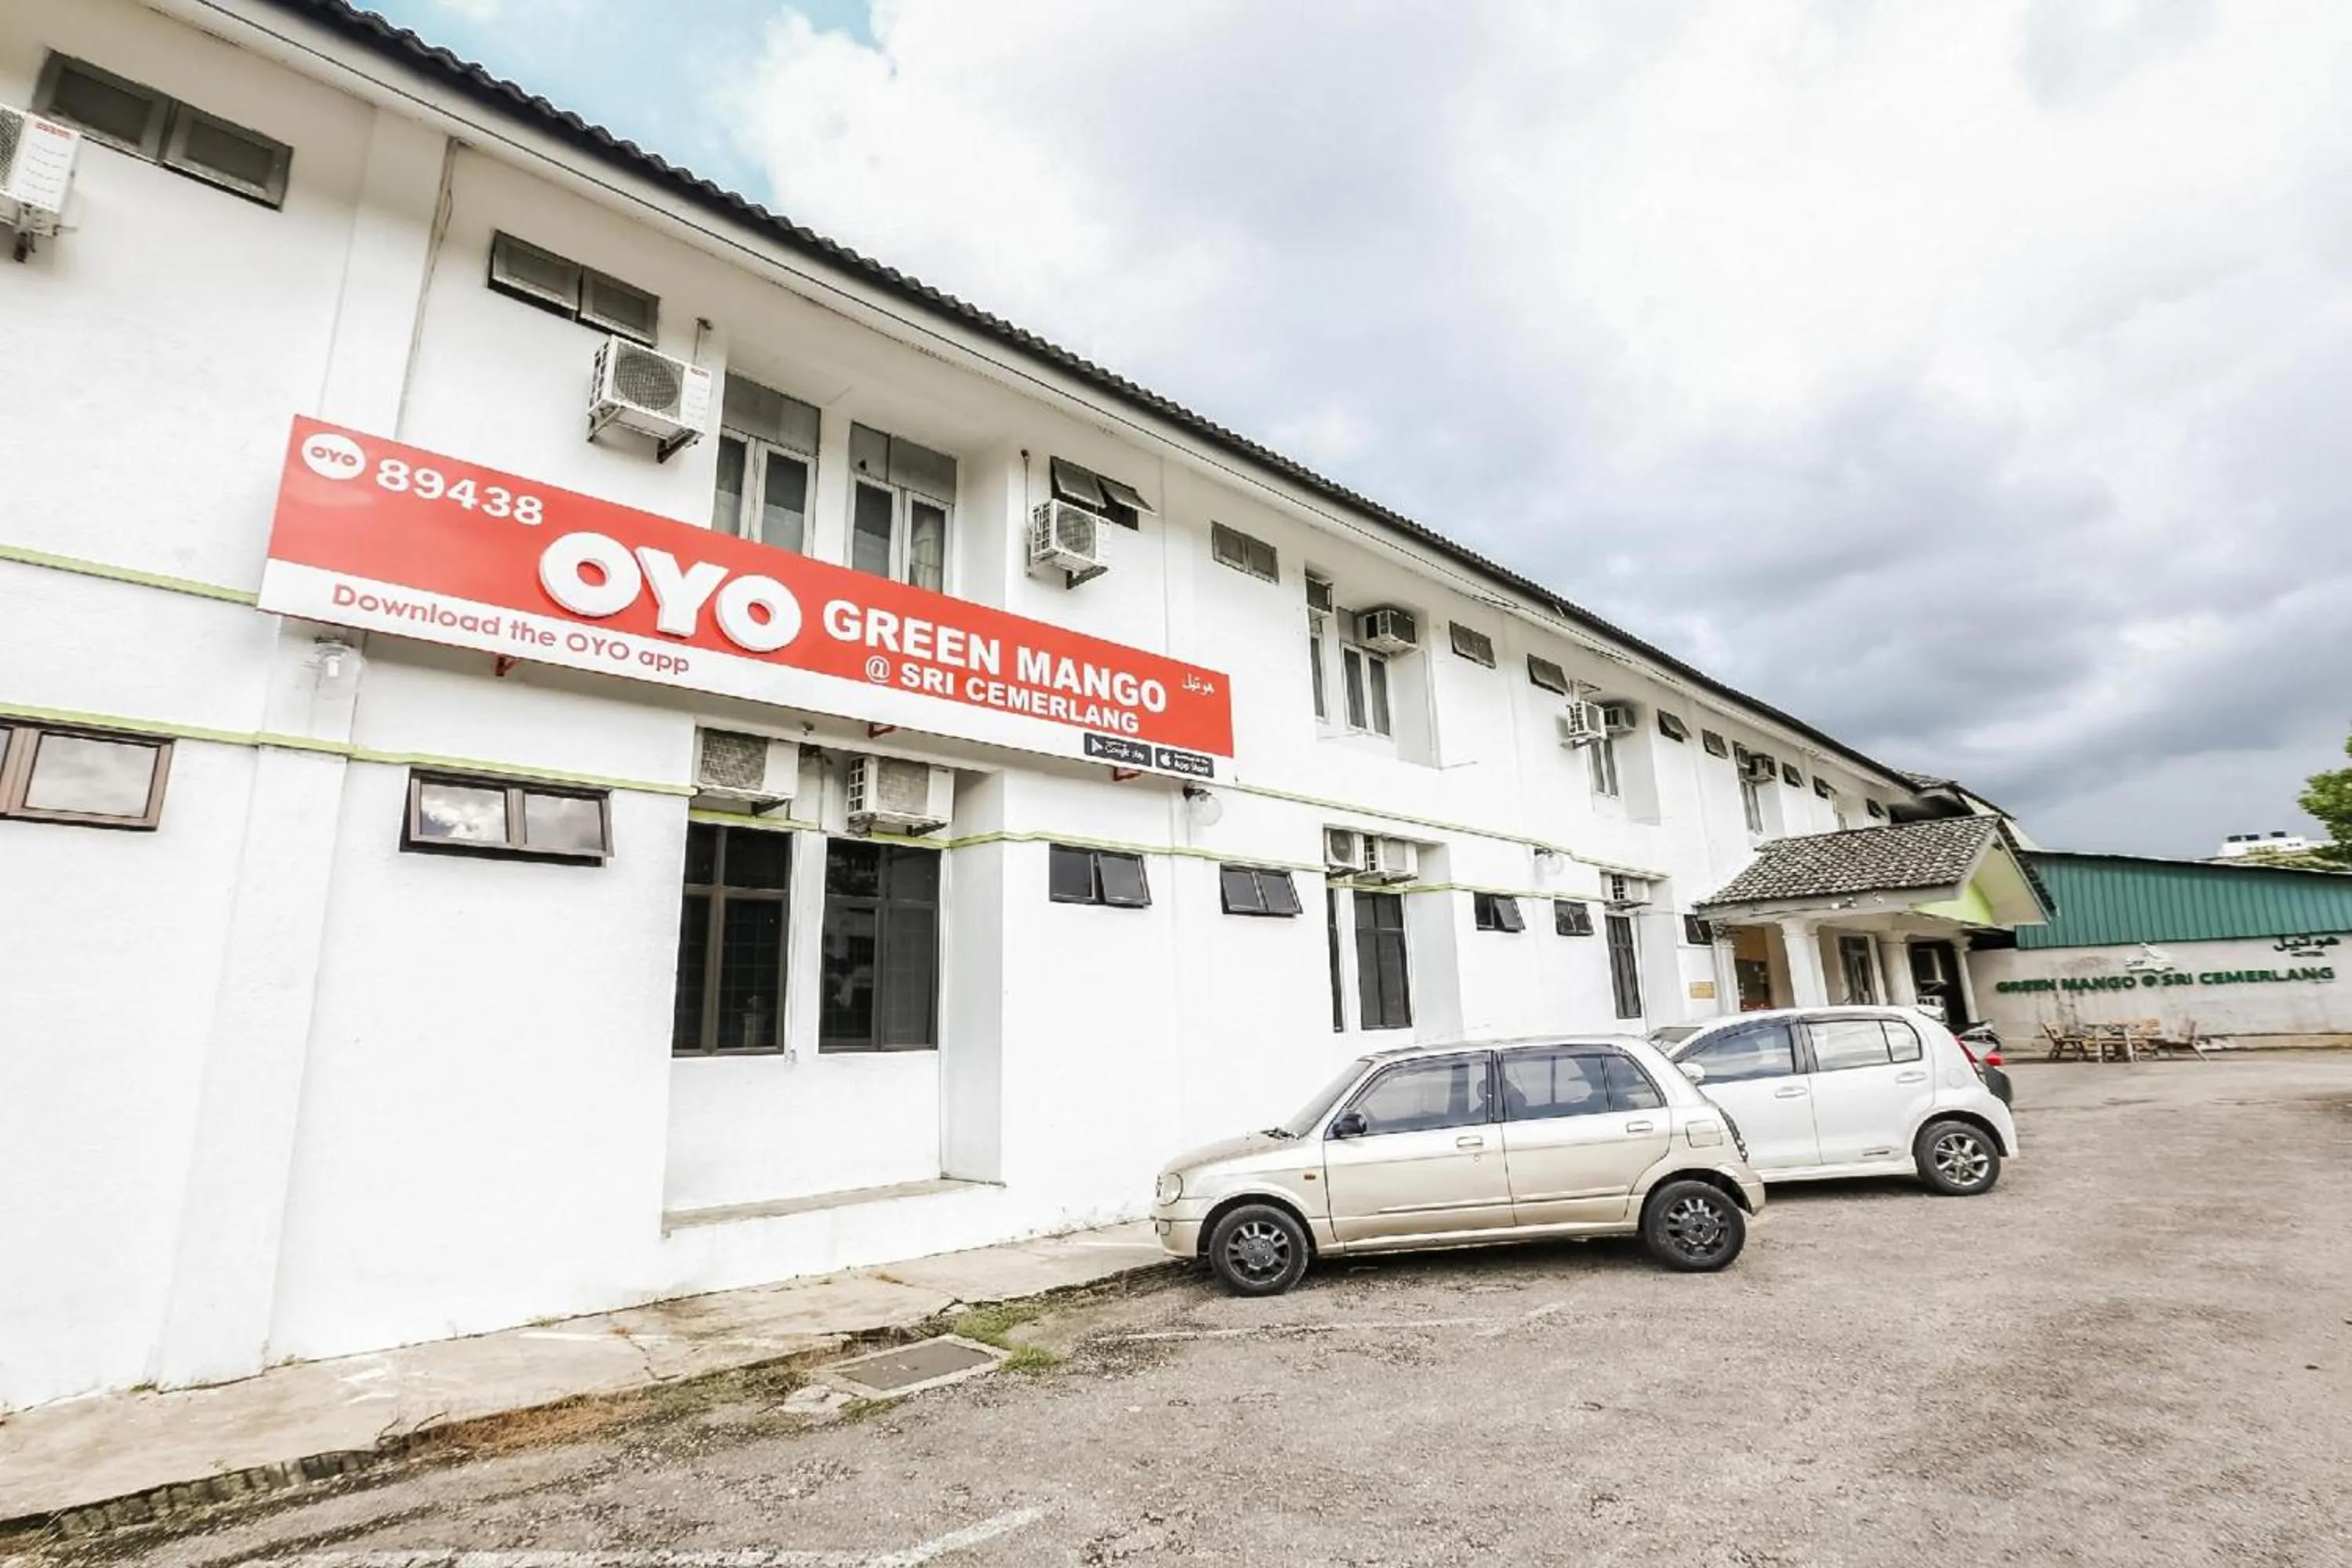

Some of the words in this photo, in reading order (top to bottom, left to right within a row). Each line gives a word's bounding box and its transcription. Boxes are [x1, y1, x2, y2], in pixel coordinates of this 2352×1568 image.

[310, 445, 358, 467] OYO
[376, 459, 543, 525] 89438
[332, 583, 500, 637] Download
[510, 620, 556, 648] the
[566, 633, 629, 661] OYO
[638, 648, 689, 674] app
[539, 532, 801, 652] OYO
[823, 600, 1000, 675] GREEN
[1018, 646, 1166, 713] MANGO
[865, 656, 891, 682] @
[900, 662, 954, 695] SRI
[965, 676, 1138, 734] CEMERLANG
[1996, 978, 2057, 993] GREEN
[2061, 976, 2136, 990] MANGO
[2161, 972, 2193, 986] SRI
[2198, 967, 2336, 985] CEMERLANG
